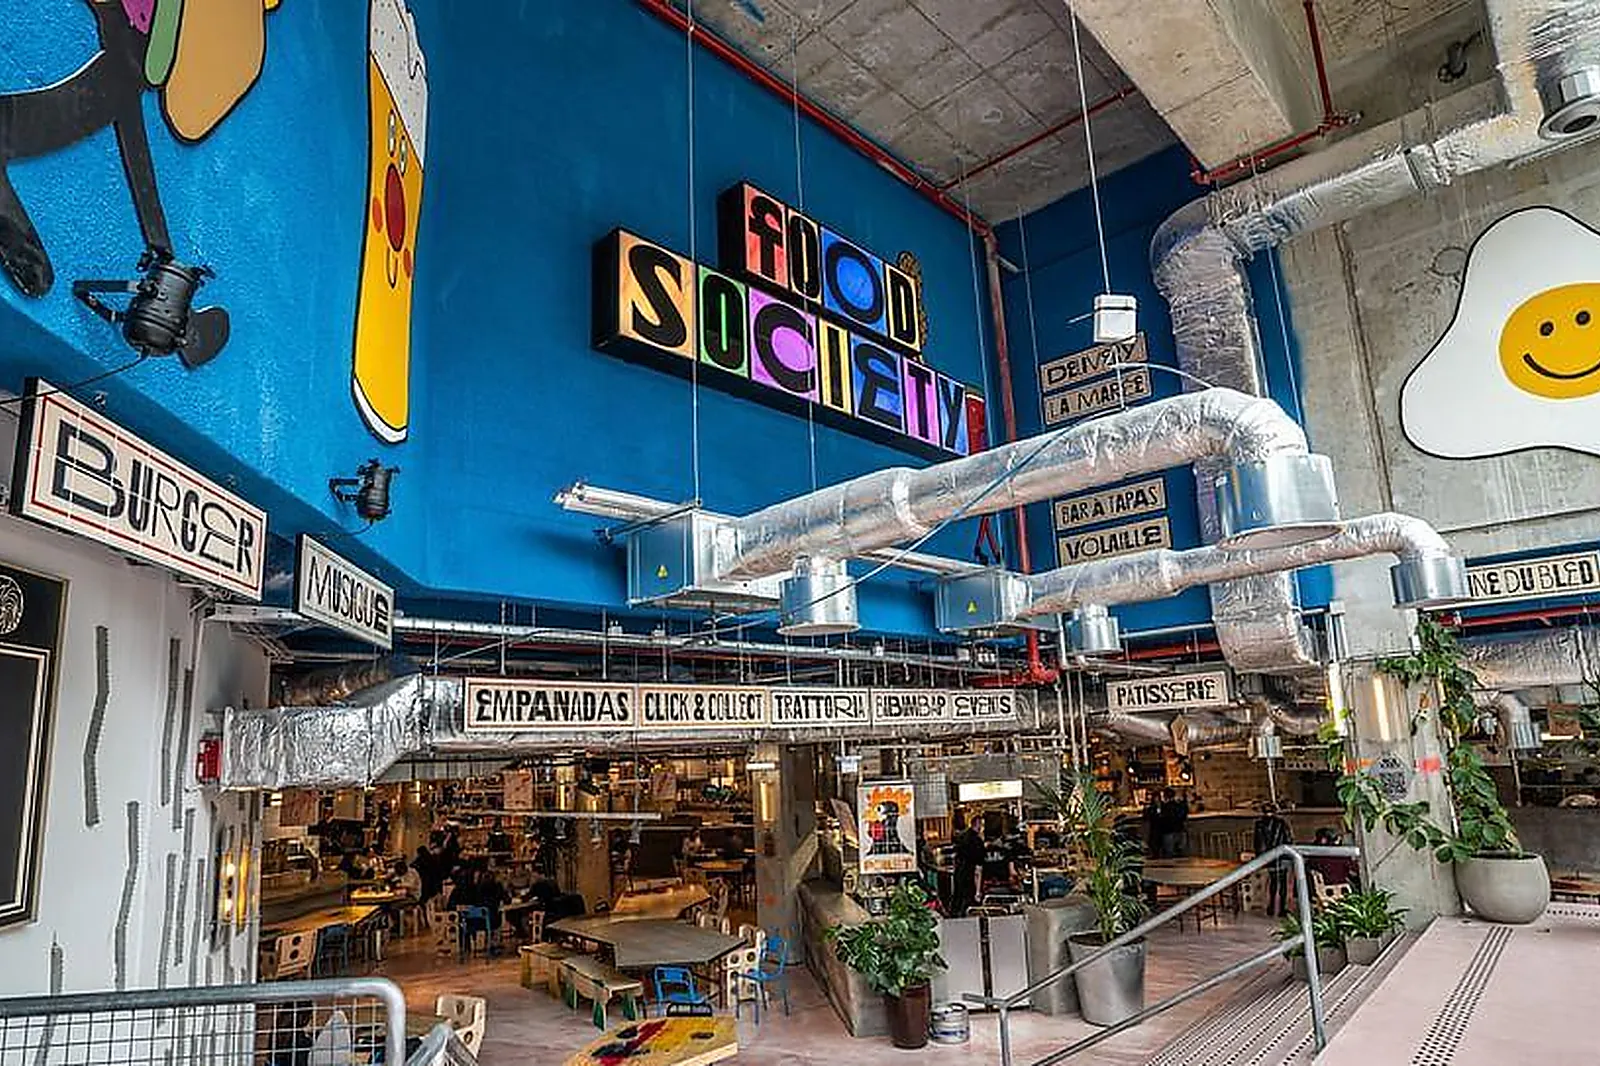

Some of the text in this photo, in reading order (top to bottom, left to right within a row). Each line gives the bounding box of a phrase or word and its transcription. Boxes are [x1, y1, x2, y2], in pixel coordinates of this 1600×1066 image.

[628, 244, 965, 450] SOCIETY
[52, 420, 254, 577] BURGER
[1062, 503, 1089, 524] BAR
[1110, 487, 1158, 513] TAPAS
[1066, 526, 1161, 560] VOLAILLE
[306, 555, 389, 635] MUSIQUE
[476, 689, 628, 721] EMPANADAS
[645, 692, 761, 721] CLICK & COLLECT
